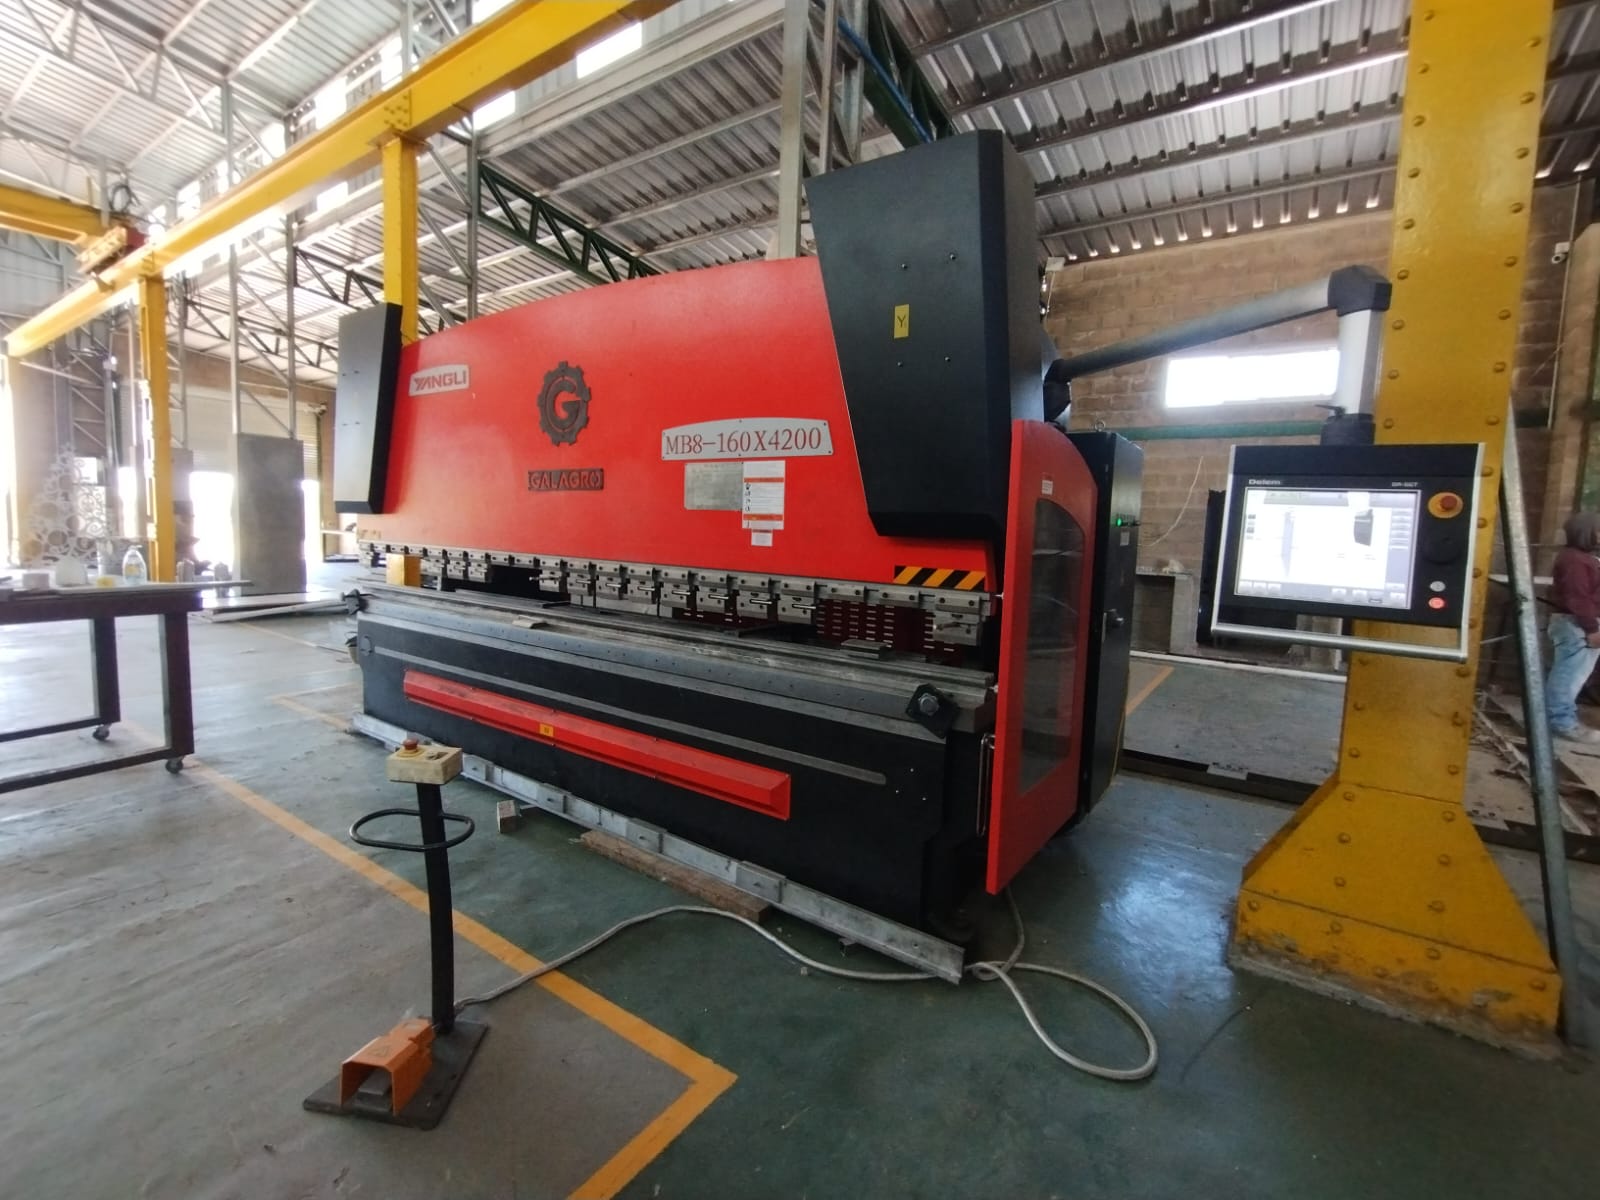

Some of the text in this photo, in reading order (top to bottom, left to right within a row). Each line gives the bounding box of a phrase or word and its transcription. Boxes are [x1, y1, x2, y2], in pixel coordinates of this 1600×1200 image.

[413, 370, 467, 391] YANGLI
[665, 427, 822, 455] MB8-160X4200
[530, 471, 602, 489] GALAGRO
